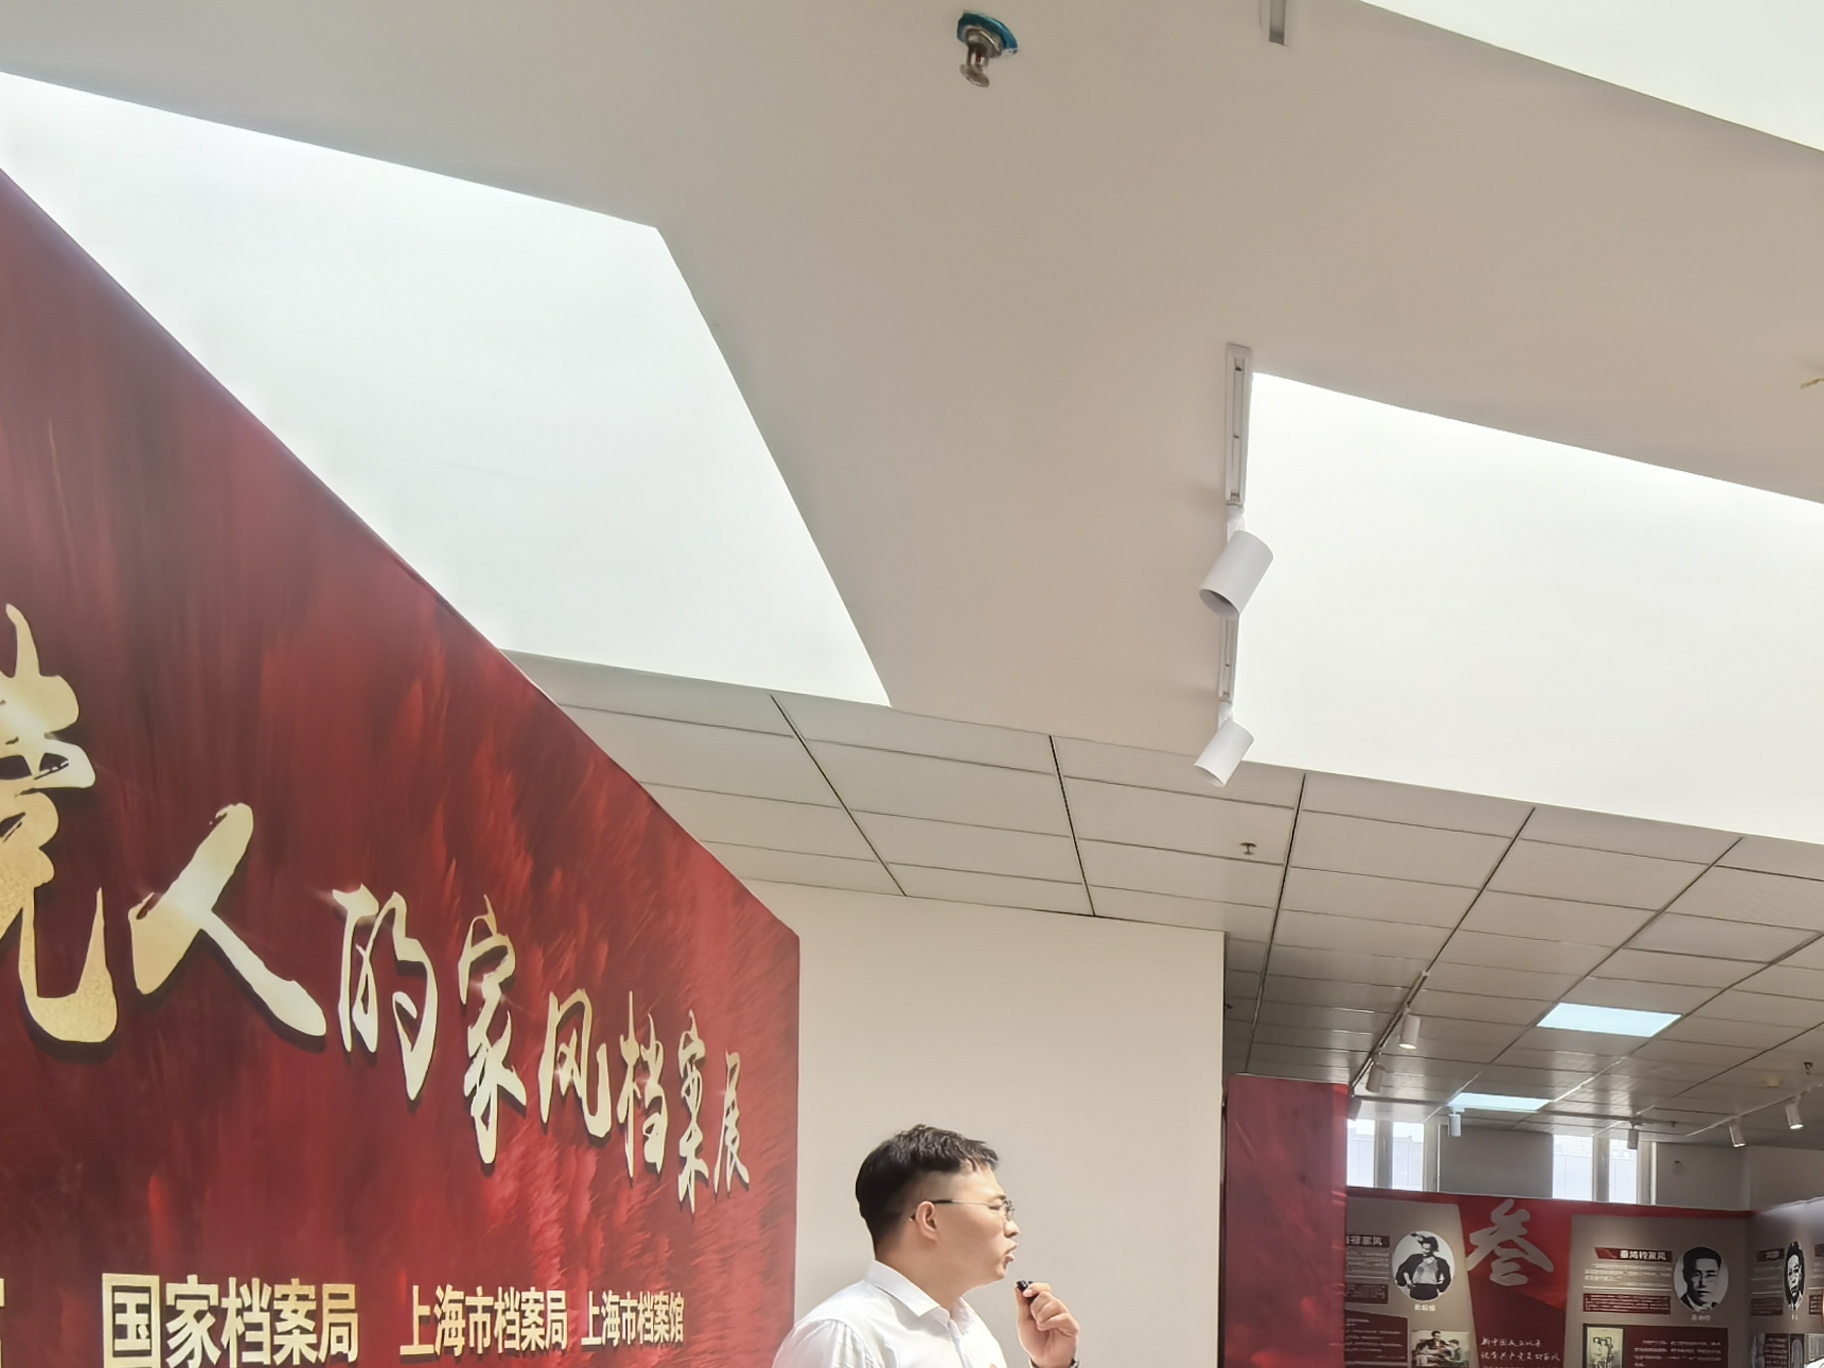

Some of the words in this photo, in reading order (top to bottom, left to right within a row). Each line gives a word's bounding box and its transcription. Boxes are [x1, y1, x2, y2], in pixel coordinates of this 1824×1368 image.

[400, 1285, 567, 1356] 上海市档案局
[581, 1290, 685, 1347] 上海市档案馆
